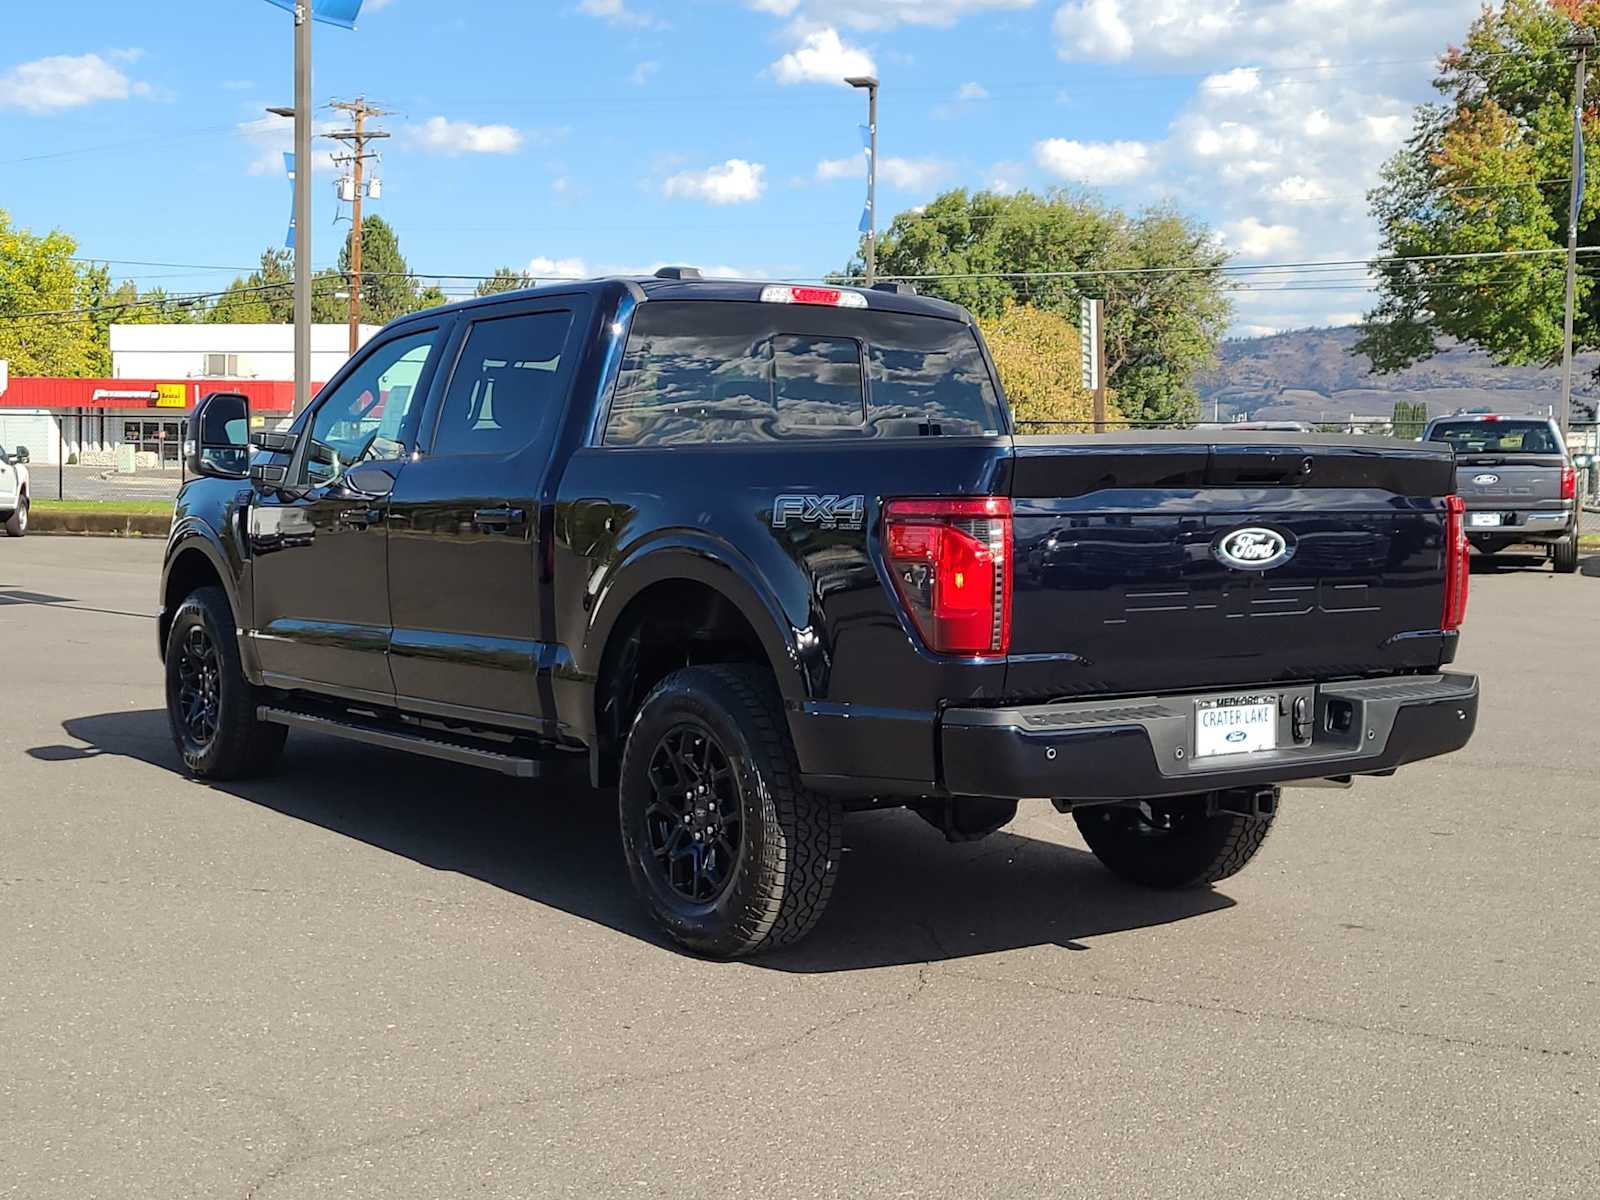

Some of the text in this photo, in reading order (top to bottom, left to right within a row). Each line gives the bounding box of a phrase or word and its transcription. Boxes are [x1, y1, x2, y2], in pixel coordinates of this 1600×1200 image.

[772, 494, 865, 528] FX4
[1231, 532, 1276, 559] Ford
[1216, 695, 1259, 708] MEDFORD
[1203, 707, 1269, 728] CRATER LAKE
